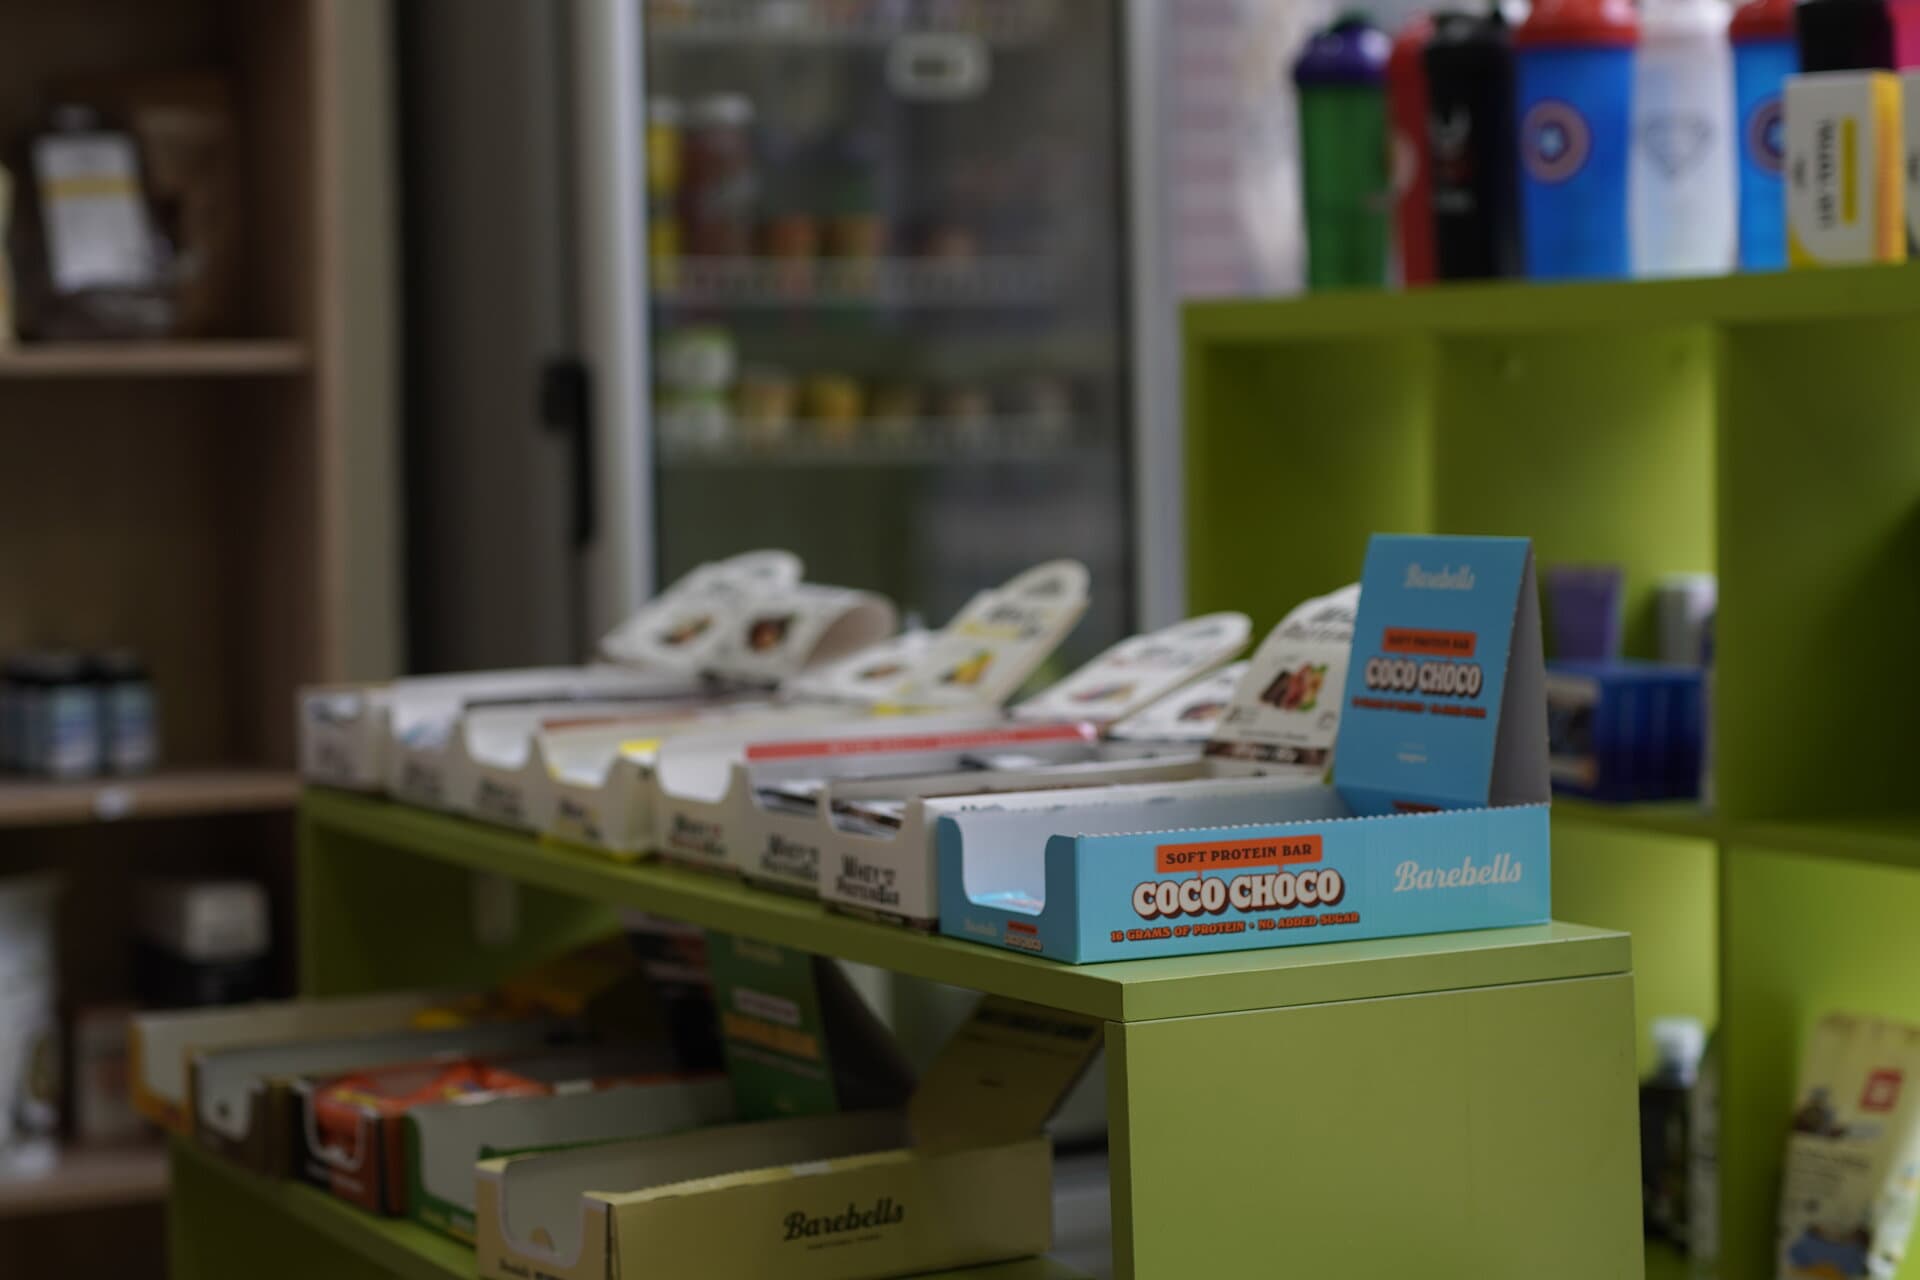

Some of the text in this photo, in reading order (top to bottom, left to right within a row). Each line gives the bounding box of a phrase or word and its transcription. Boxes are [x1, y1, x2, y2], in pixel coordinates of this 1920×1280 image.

[1365, 656, 1484, 699] COCO CHOCO
[1165, 843, 1313, 865] SOFT PROTEIN BAR
[1393, 852, 1523, 892] Barebells
[1132, 867, 1345, 920] COCO CHOCO
[1110, 911, 1360, 943] 16 GRAMS OF PROTEIN NO ADDED SUGAR
[783, 1197, 905, 1242] Barebells
